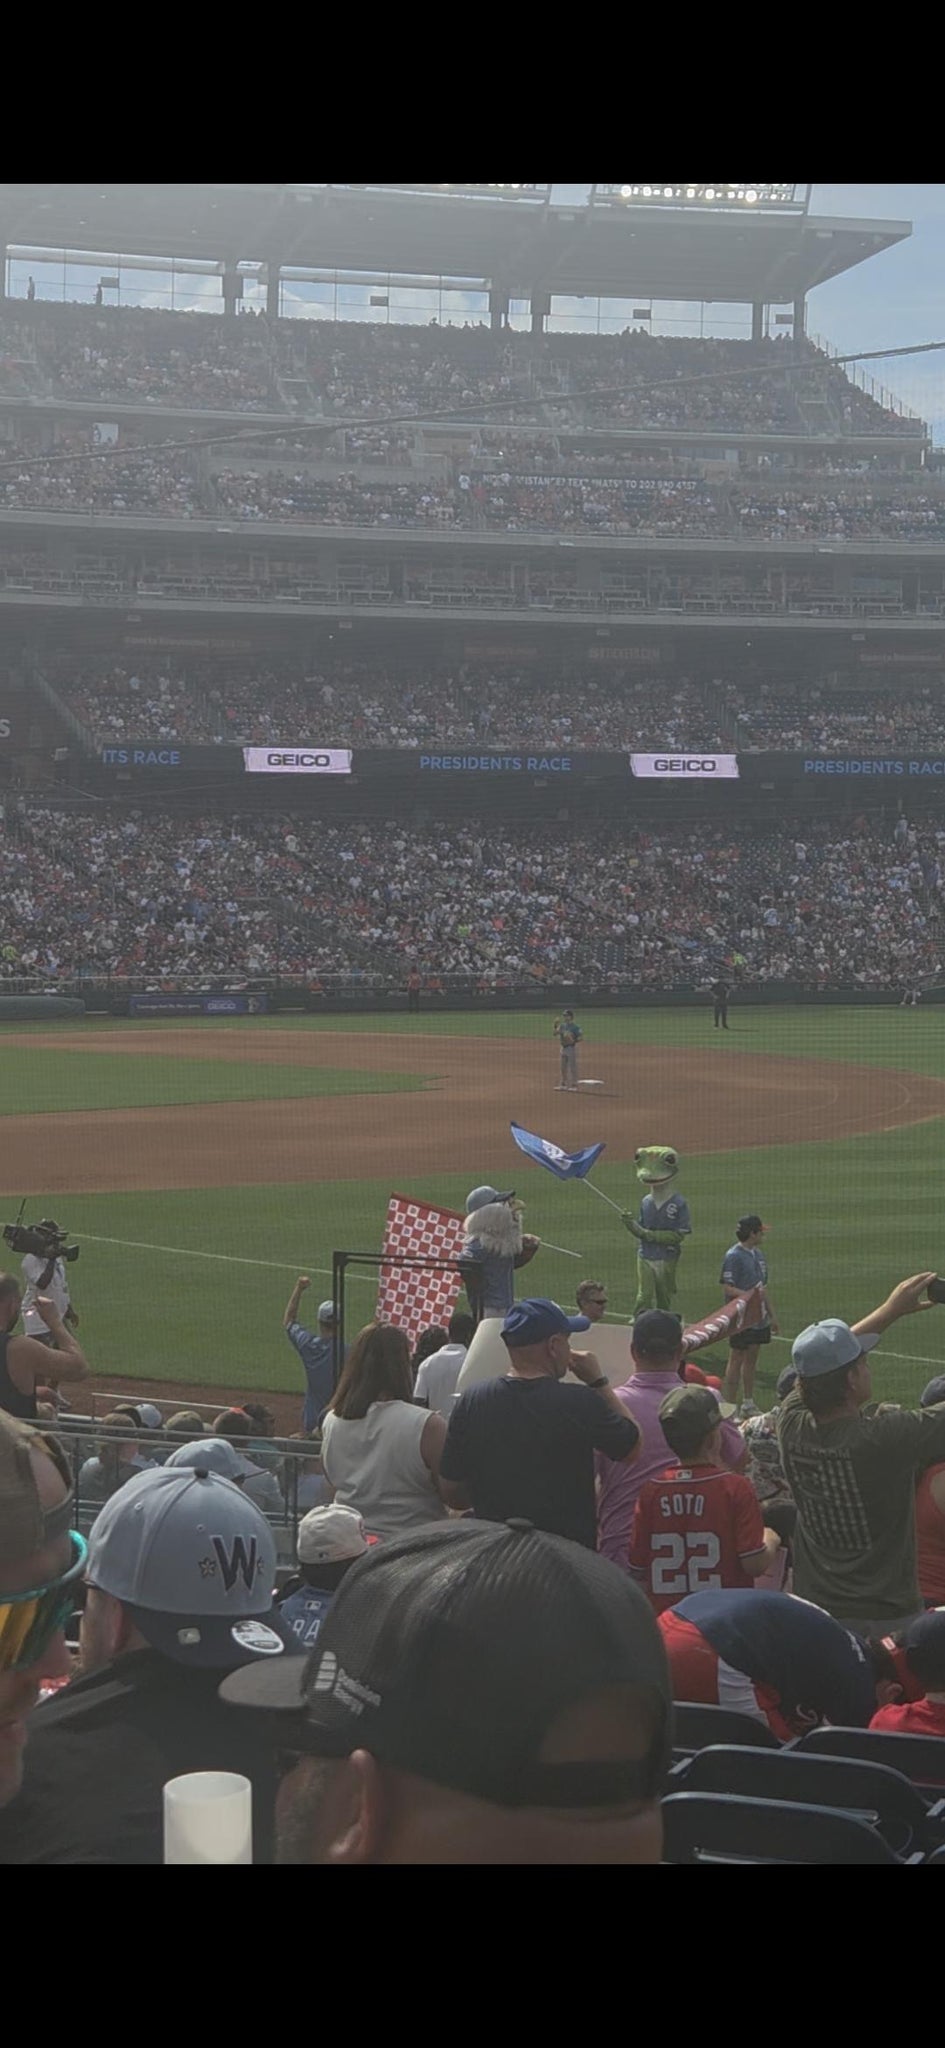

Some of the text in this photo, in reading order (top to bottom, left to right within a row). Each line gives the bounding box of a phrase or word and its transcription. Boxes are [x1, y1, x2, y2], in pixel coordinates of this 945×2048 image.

[134, 750, 181, 765] RACE
[267, 753, 330, 767] GEICO
[419, 755, 572, 771] PRESIDENTS RACE
[654, 759, 716, 772] GEICO
[804, 760, 945, 775] PRESIDENTS RAC
[660, 1493, 705, 1517] SOTO
[211, 1534, 258, 1596] W
[651, 1532, 722, 1594] 22
